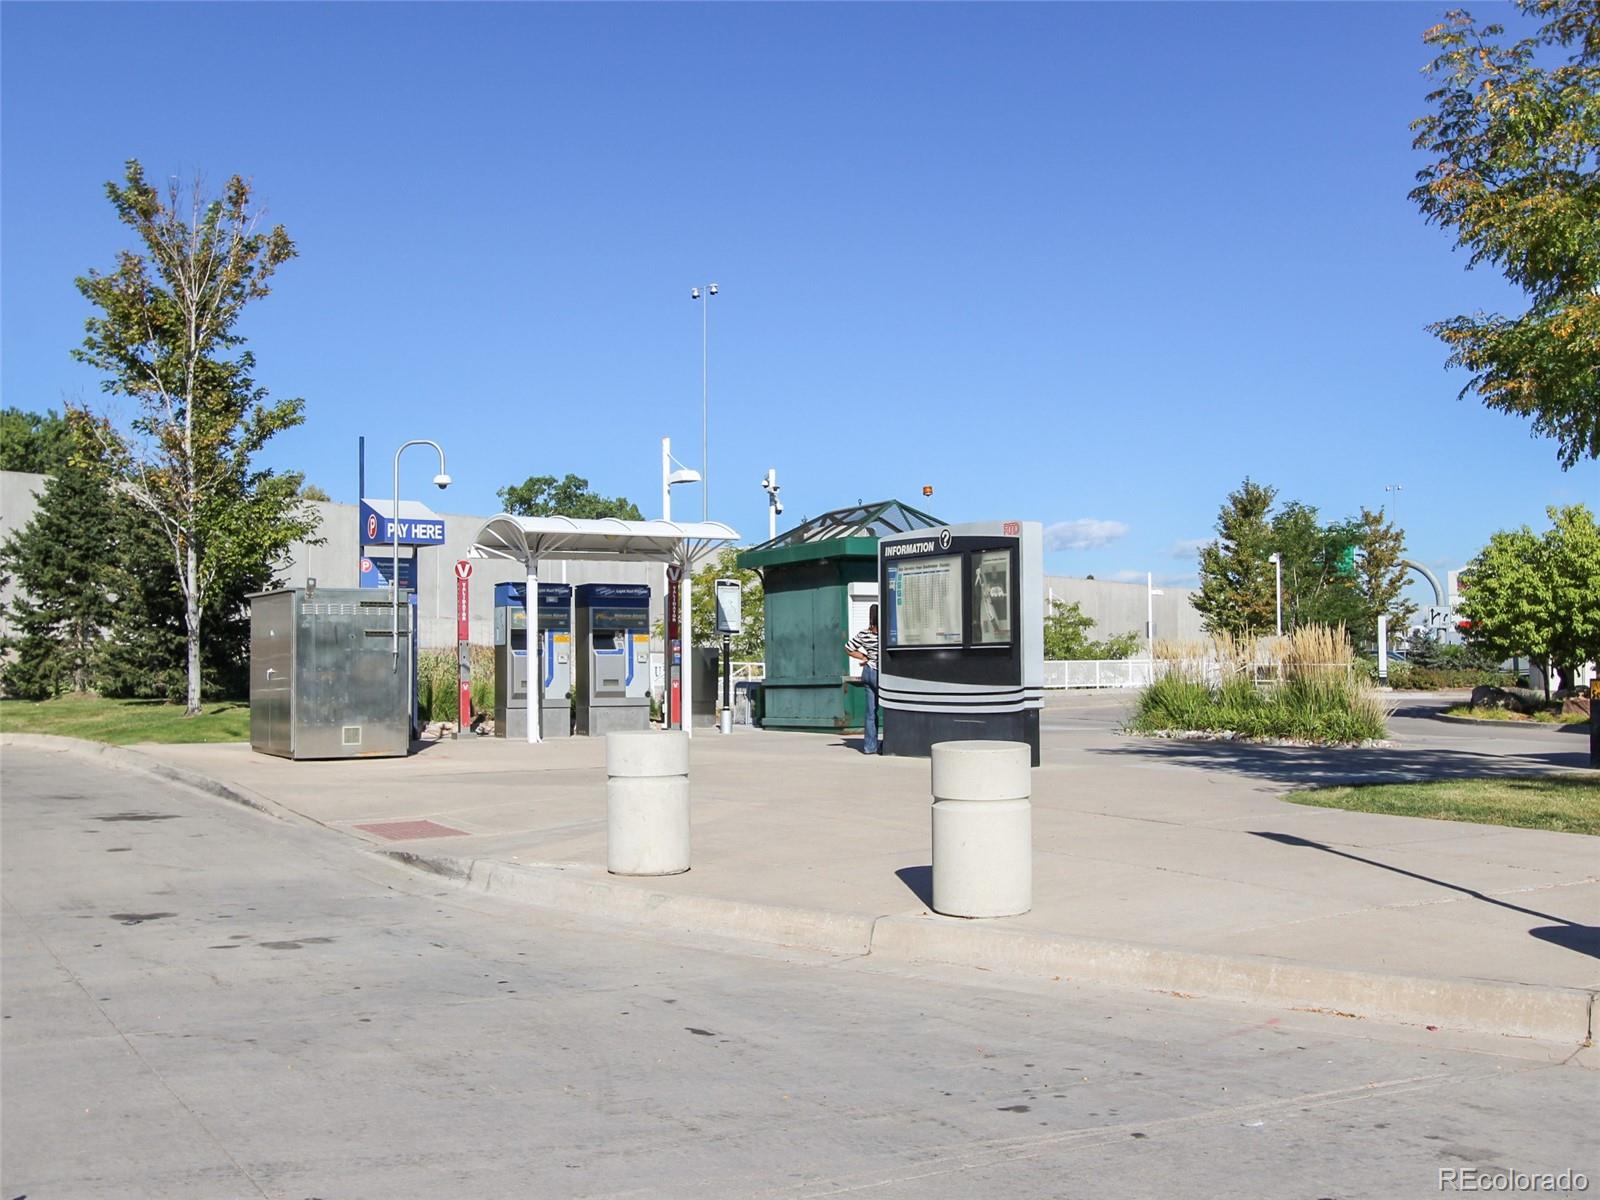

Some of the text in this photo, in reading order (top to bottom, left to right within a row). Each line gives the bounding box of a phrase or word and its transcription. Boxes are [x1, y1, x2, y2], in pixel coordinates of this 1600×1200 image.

[411, 523, 443, 540] HERE
[884, 541, 935, 557] INFORMATION
[456, 563, 470, 578] V
[669, 567, 680, 581] V
